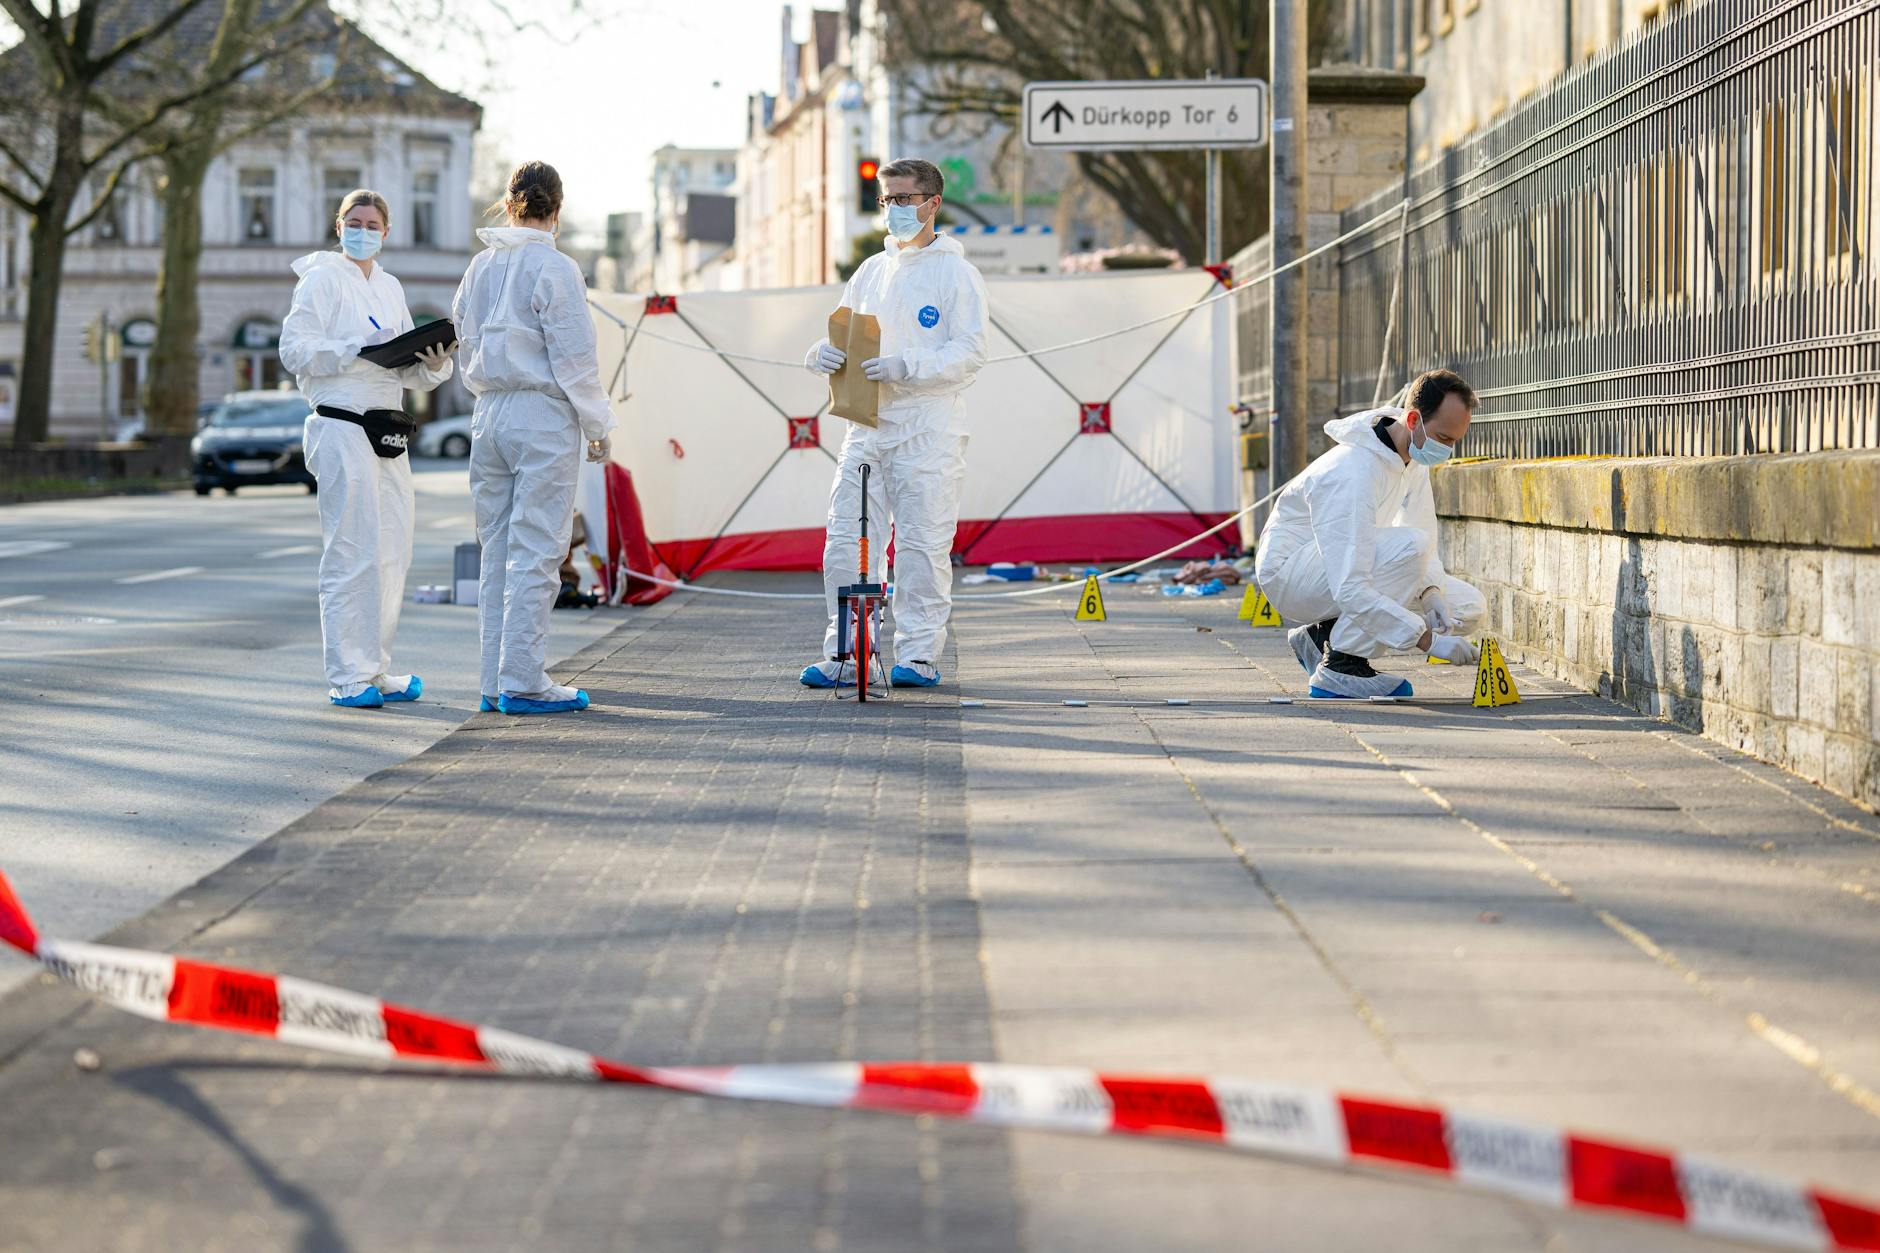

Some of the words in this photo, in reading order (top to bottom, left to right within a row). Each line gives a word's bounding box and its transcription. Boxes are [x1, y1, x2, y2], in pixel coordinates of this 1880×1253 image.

[1082, 106, 1171, 128] Dürkopp
[1181, 105, 1215, 124] Tor
[1226, 105, 1239, 124] 6
[1086, 594, 1096, 614] 6
[1260, 599, 1272, 620] 4
[1480, 668, 1488, 697] 8
[1495, 667, 1509, 695] 8
